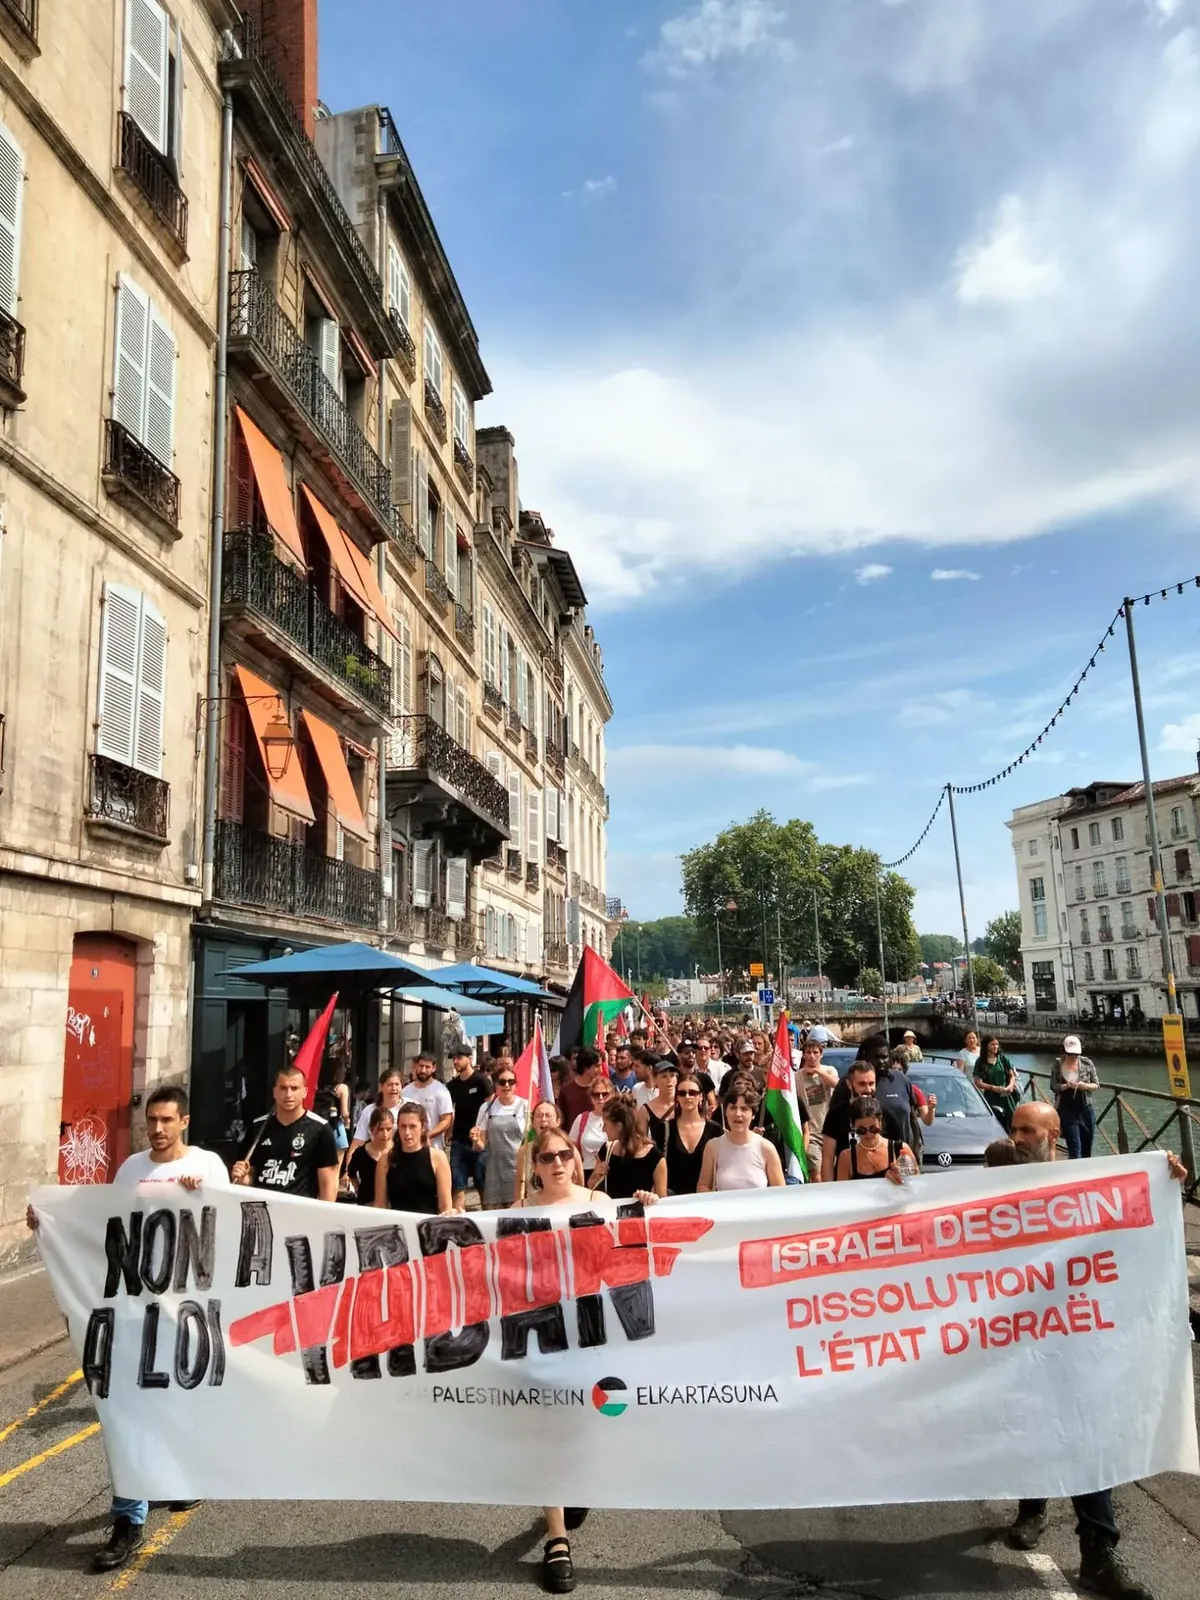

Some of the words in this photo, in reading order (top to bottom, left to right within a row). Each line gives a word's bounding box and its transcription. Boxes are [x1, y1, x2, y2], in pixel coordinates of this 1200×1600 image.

[103, 1205, 217, 1298] NON
[234, 1200, 274, 1288] A
[771, 1223, 921, 1273] ISRAEL
[933, 1186, 1124, 1248] DESEGIN
[786, 1260, 1055, 1330] DISSOLUTION
[1066, 1250, 1119, 1286] DE
[136, 1298, 226, 1390] LOI
[796, 1327, 926, 1378] L'ÉTAT
[939, 1292, 1116, 1355] D'ISRAËL
[433, 1386, 584, 1407] PALESTINAREKIN
[636, 1384, 779, 1406] ELKARTASUNA
